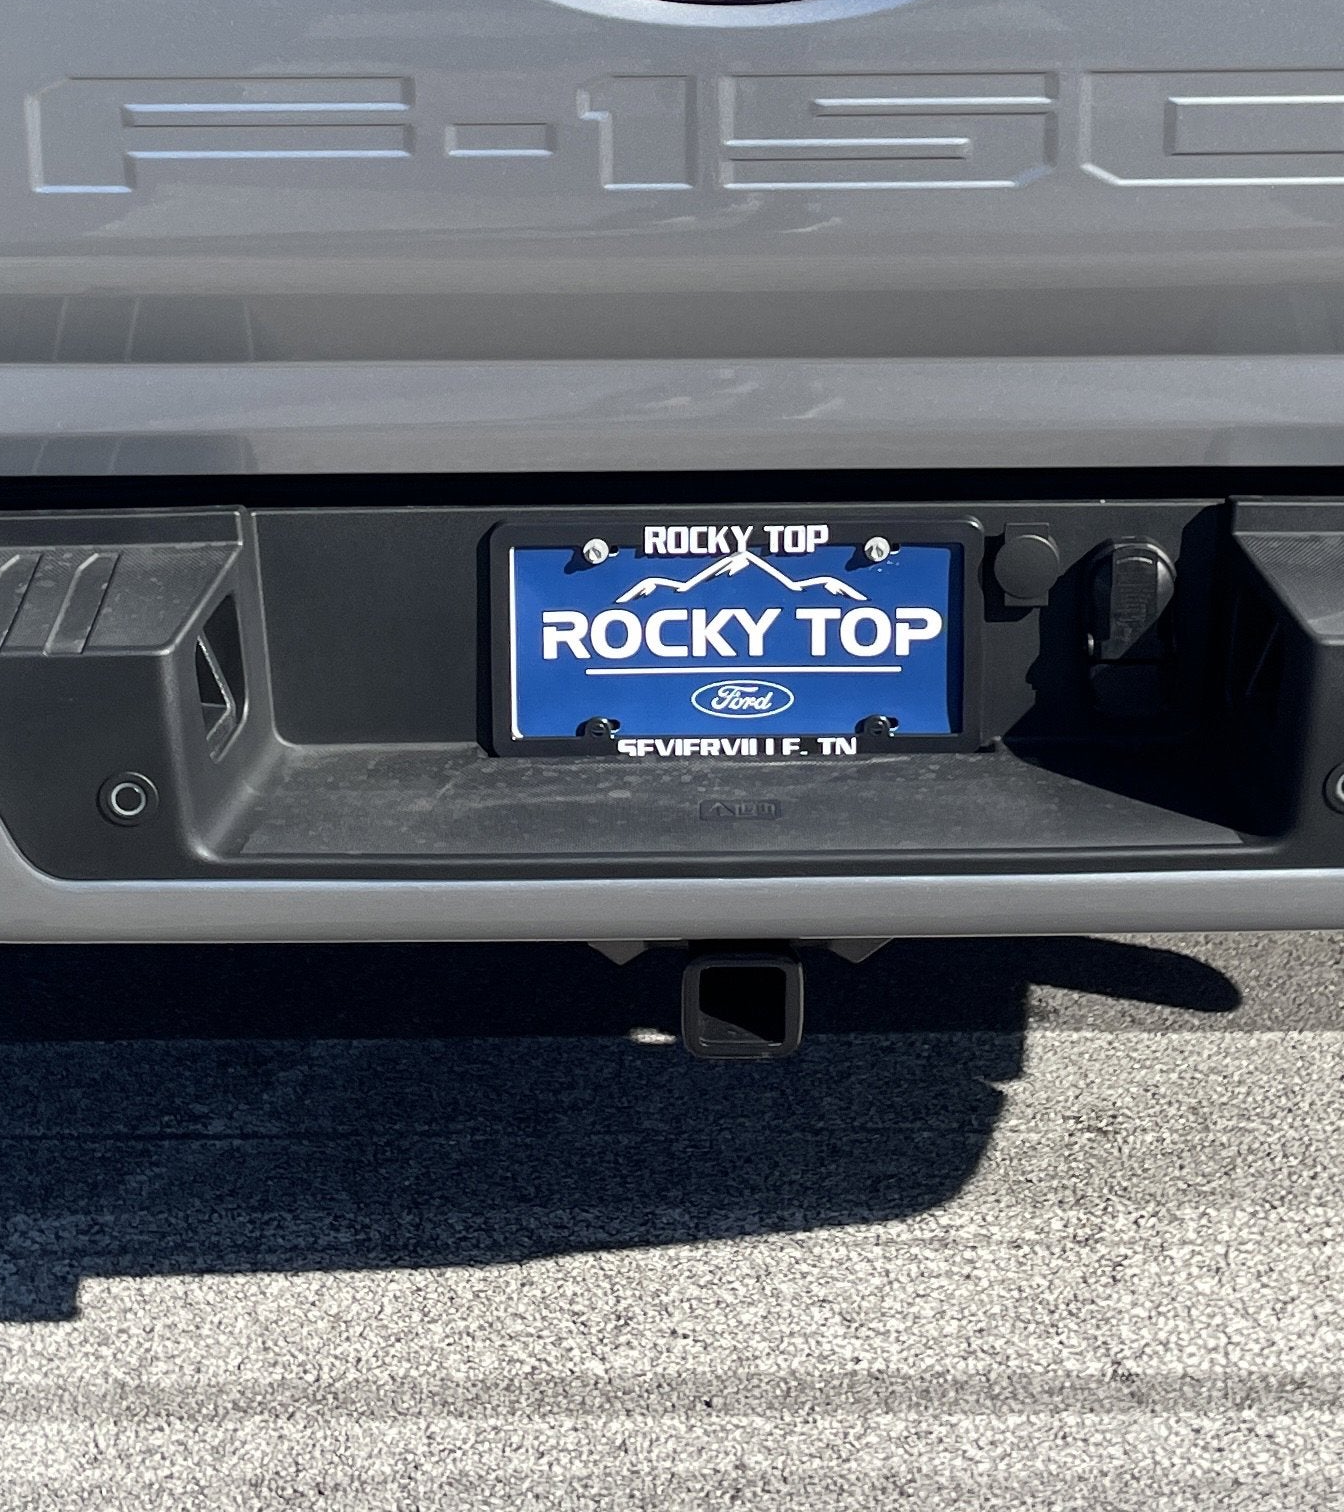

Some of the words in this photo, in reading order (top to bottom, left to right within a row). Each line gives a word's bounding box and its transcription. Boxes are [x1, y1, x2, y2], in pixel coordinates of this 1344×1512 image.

[643, 525, 753, 555] ROCKY
[764, 524, 830, 553] TOP
[542, 608, 782, 659] ROCKY
[795, 607, 943, 657] TOP
[711, 685, 773, 711] Ford
[817, 736, 856, 756] TN
